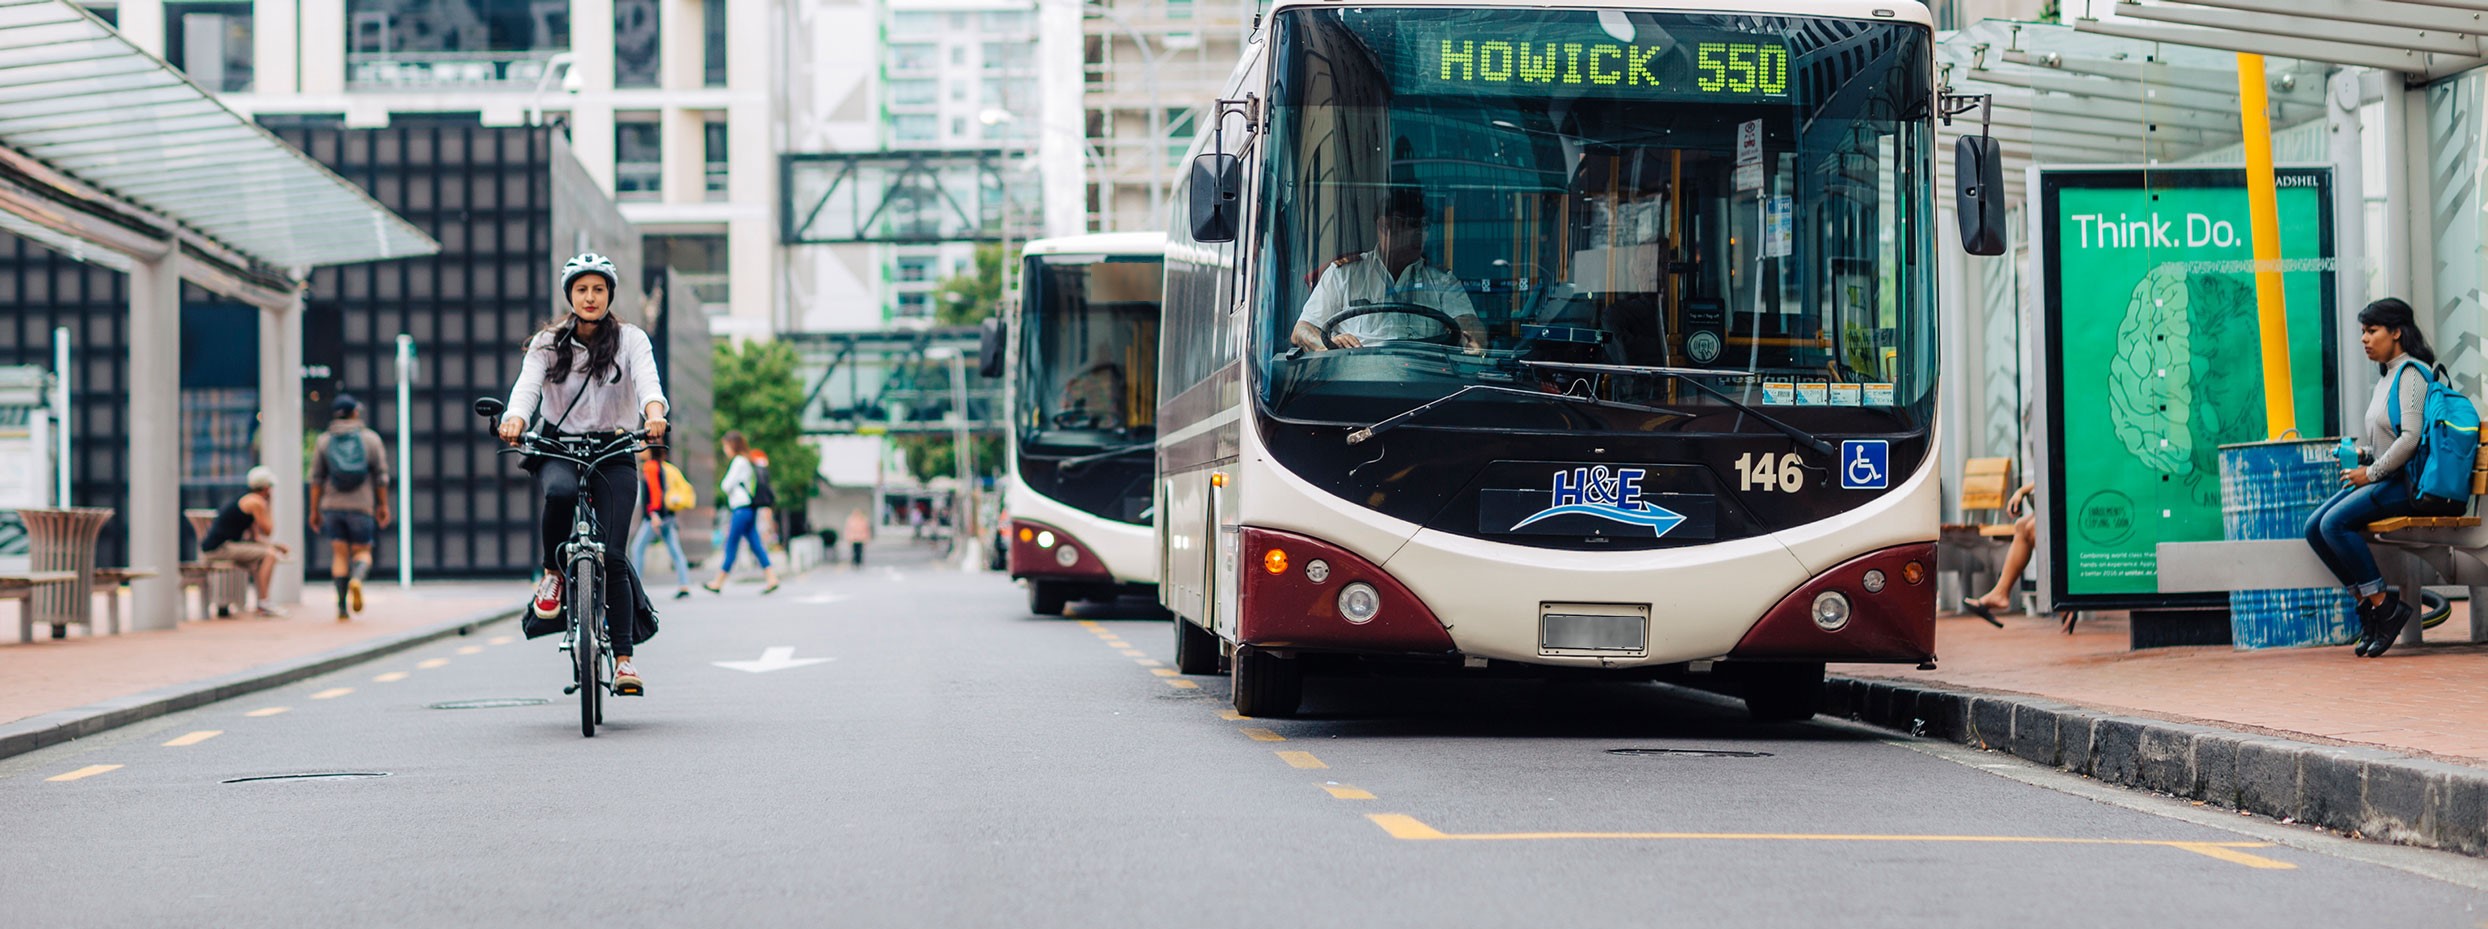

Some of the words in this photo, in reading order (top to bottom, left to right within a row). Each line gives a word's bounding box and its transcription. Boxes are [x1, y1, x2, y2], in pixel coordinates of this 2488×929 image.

[1441, 40, 1660, 86] HOWICK
[1698, 42, 1787, 93] 550
[2276, 175, 2319, 187] ADSHEL
[2071, 212, 2180, 248] Think.
[2187, 212, 2241, 248] Do.
[1551, 465, 1646, 511] H&E
[1735, 452, 1804, 493] 146
